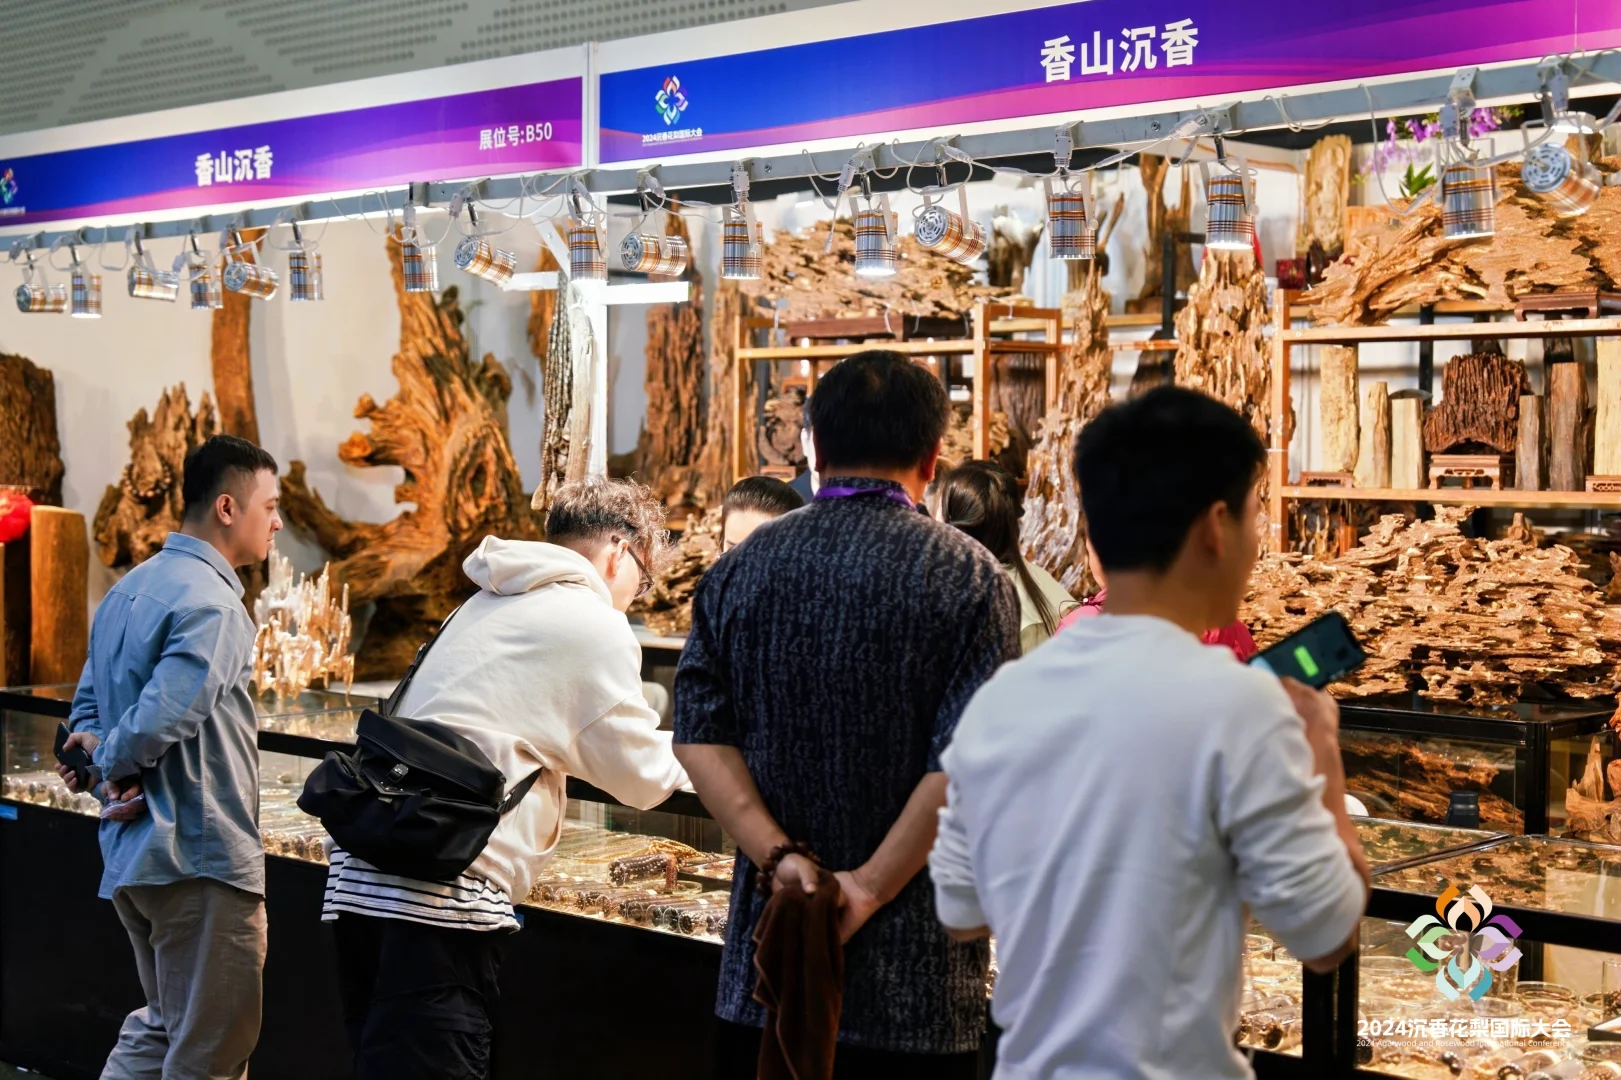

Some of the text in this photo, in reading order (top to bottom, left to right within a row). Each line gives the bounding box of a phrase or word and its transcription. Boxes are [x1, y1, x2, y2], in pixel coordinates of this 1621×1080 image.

[1040, 18, 1199, 83] 香山沉香
[479, 122, 553, 150] 展位号:B50
[195, 145, 274, 187] 香山沉香
